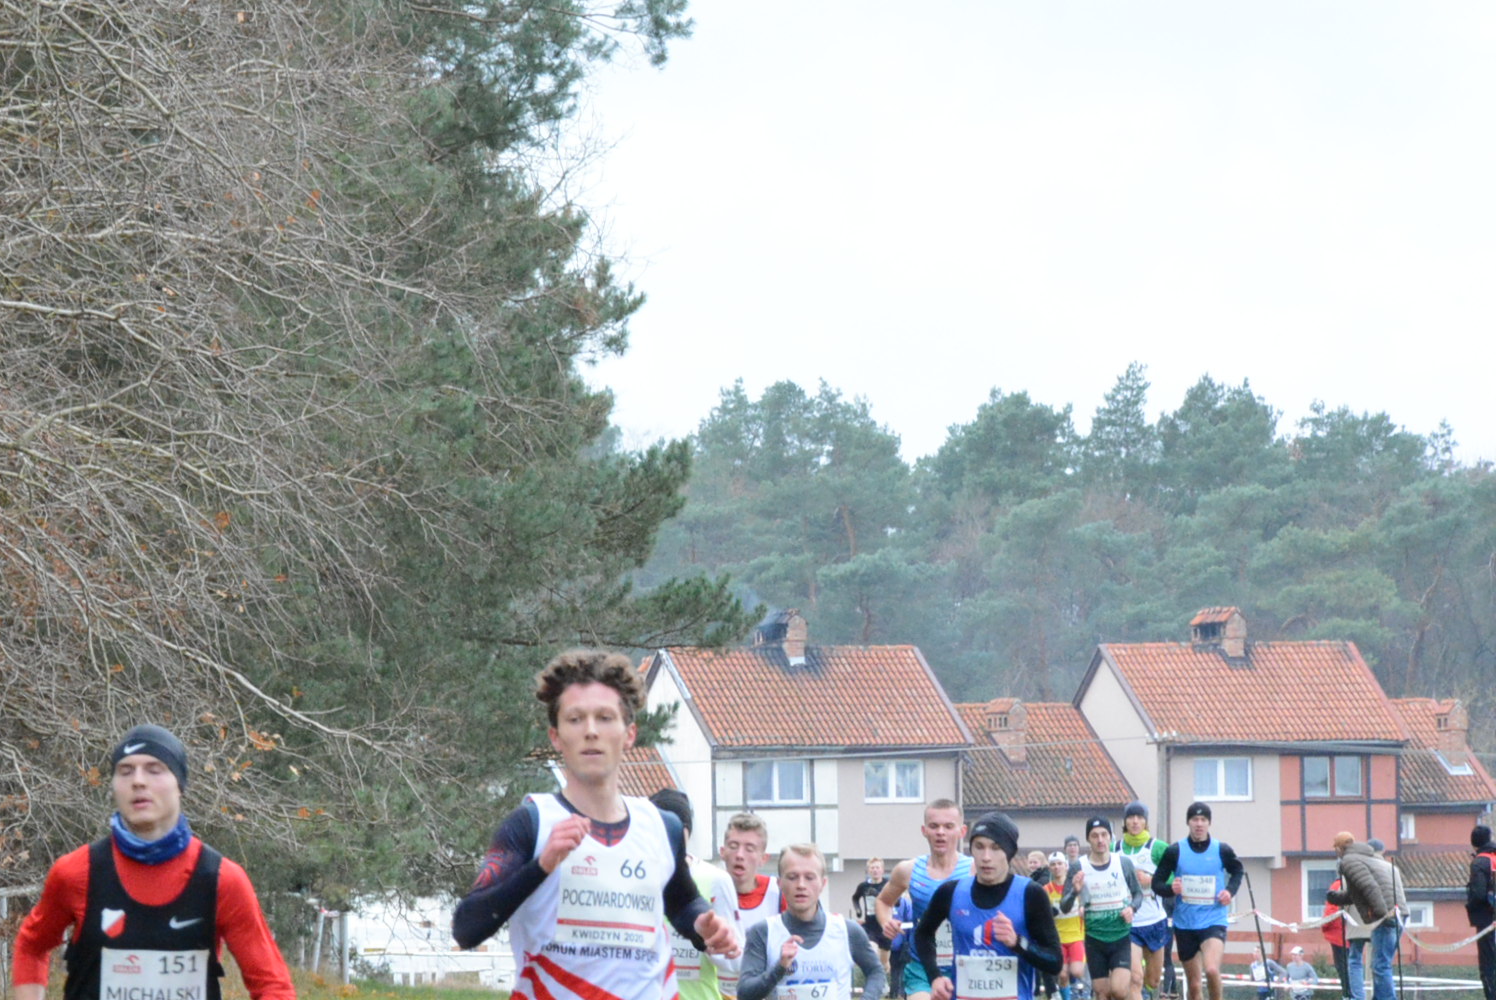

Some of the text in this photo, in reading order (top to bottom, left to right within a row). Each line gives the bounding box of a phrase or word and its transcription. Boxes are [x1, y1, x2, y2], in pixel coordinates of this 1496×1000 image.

[620, 859, 646, 879] 66
[562, 888, 655, 912] POCZWARDOWSKI
[571, 929, 644, 943] KWIDZYN 2020
[579, 945, 632, 960] MIASTEM
[159, 955, 198, 975] 151
[985, 959, 1013, 972] 253
[811, 986, 829, 999] 67
